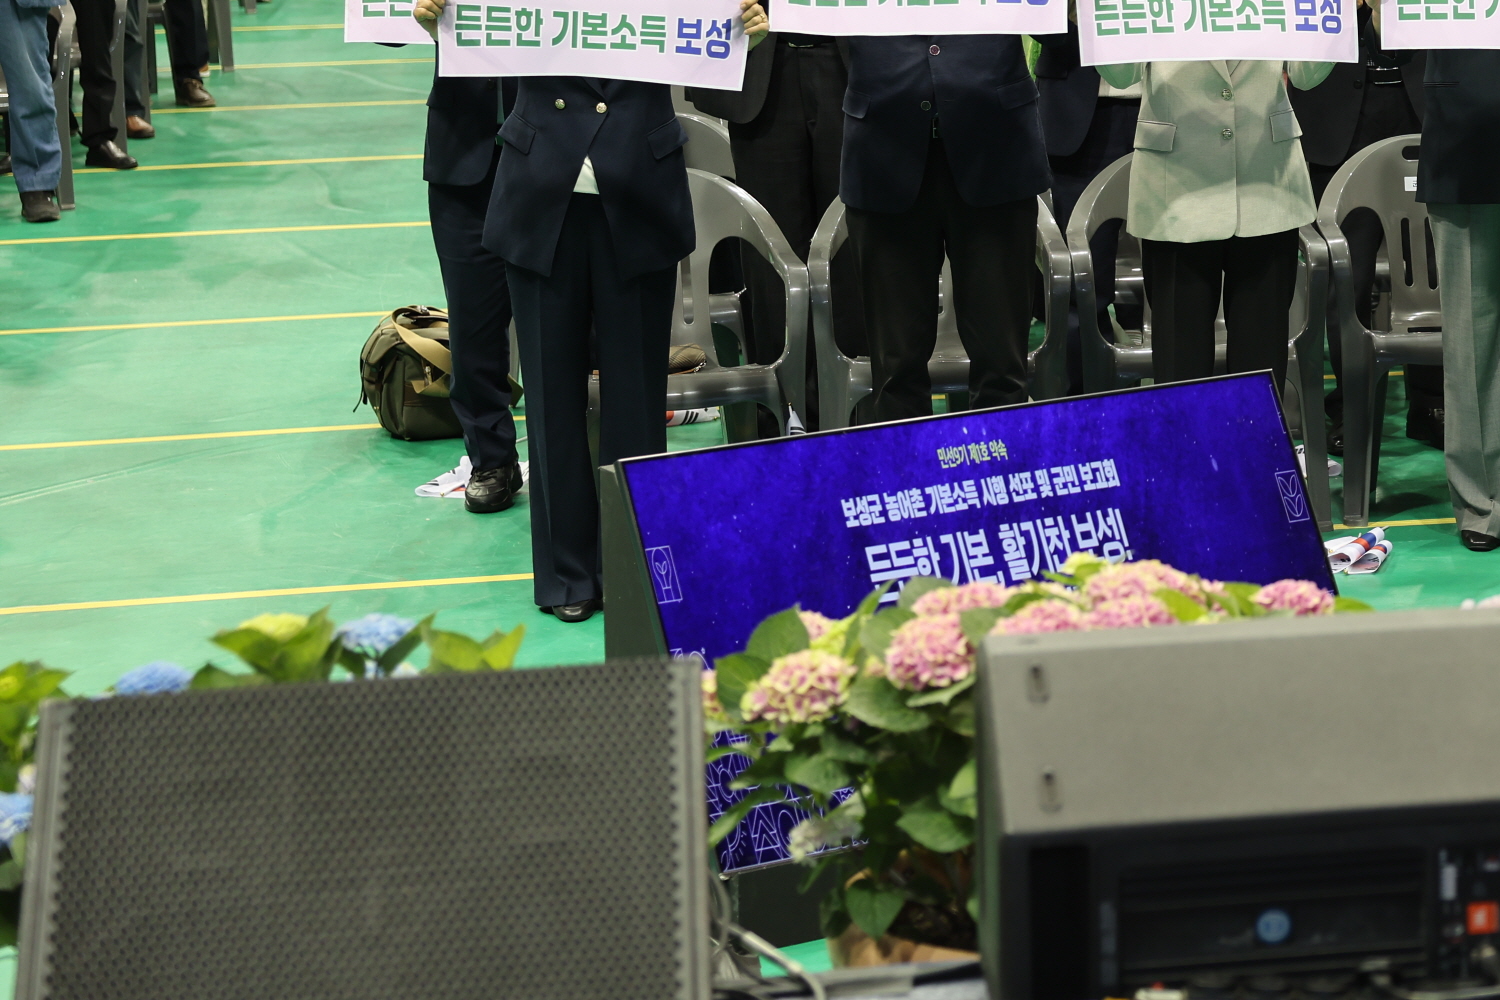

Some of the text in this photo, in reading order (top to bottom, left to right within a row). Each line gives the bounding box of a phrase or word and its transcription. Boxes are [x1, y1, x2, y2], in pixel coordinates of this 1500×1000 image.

[455, 3, 732, 60] 든든한 기본소득 보성
[937, 443, 970, 469] 민선9기
[988, 439, 1008, 461] 약속
[841, 458, 1121, 528] 보성군 농어촌 기본소득 시행 선포 및 군민 보고회
